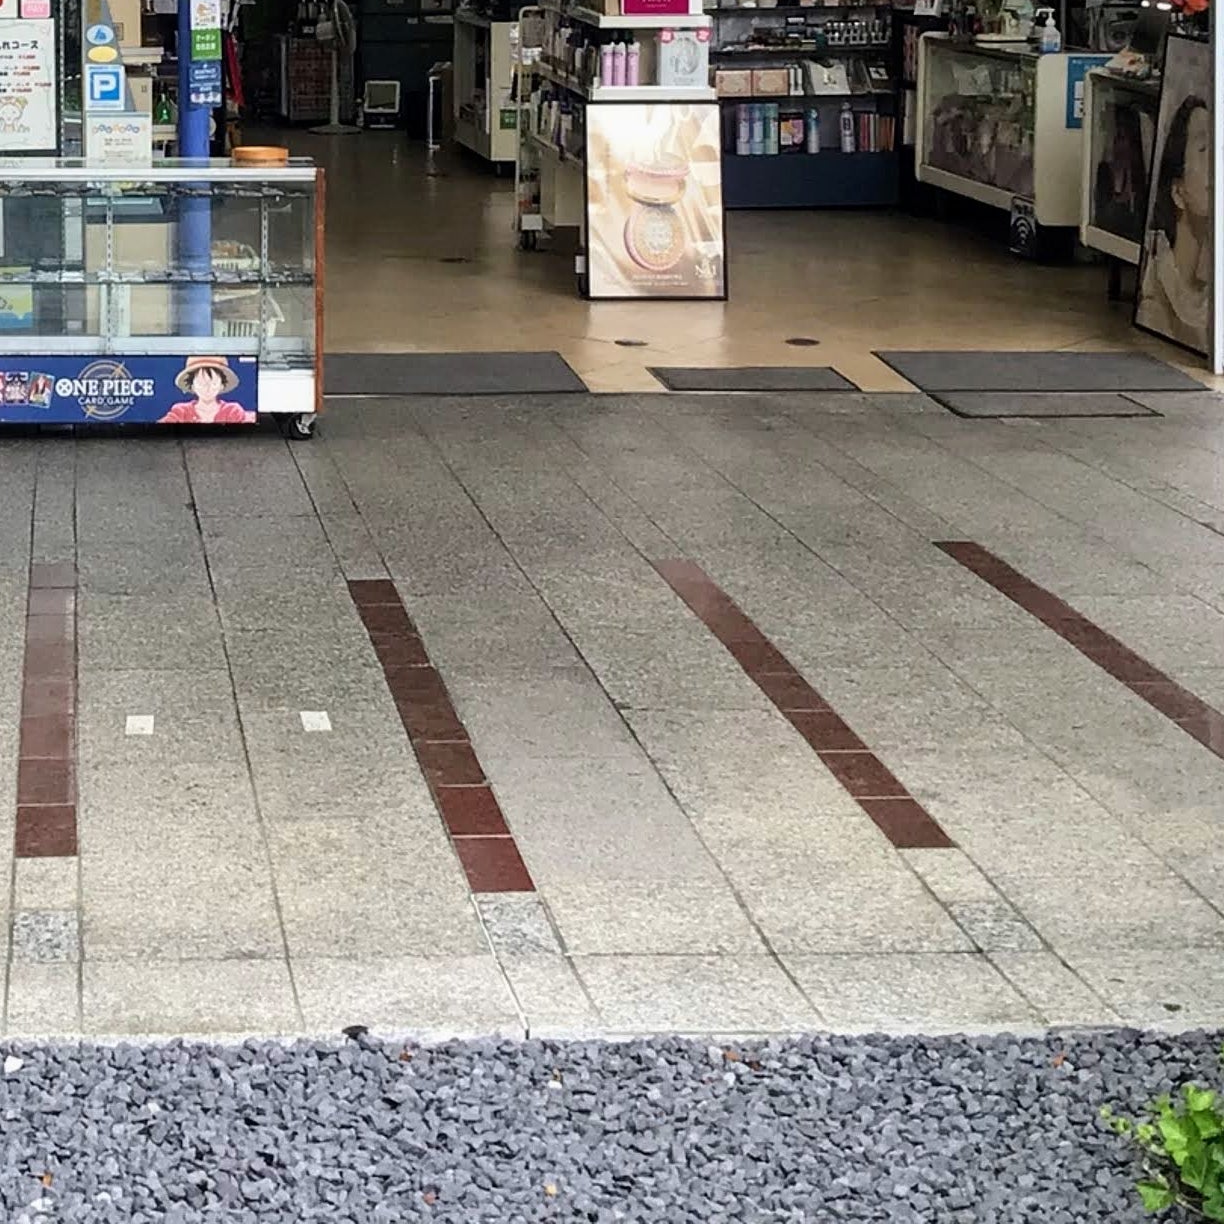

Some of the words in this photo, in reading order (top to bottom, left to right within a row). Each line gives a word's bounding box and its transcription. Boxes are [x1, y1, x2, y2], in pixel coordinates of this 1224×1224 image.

[93, 73, 117, 99] P
[55, 378, 99, 397] ONE
[102, 378, 155, 397] PIECE
[77, 396, 104, 406] CARD
[106, 396, 135, 406] GAME
